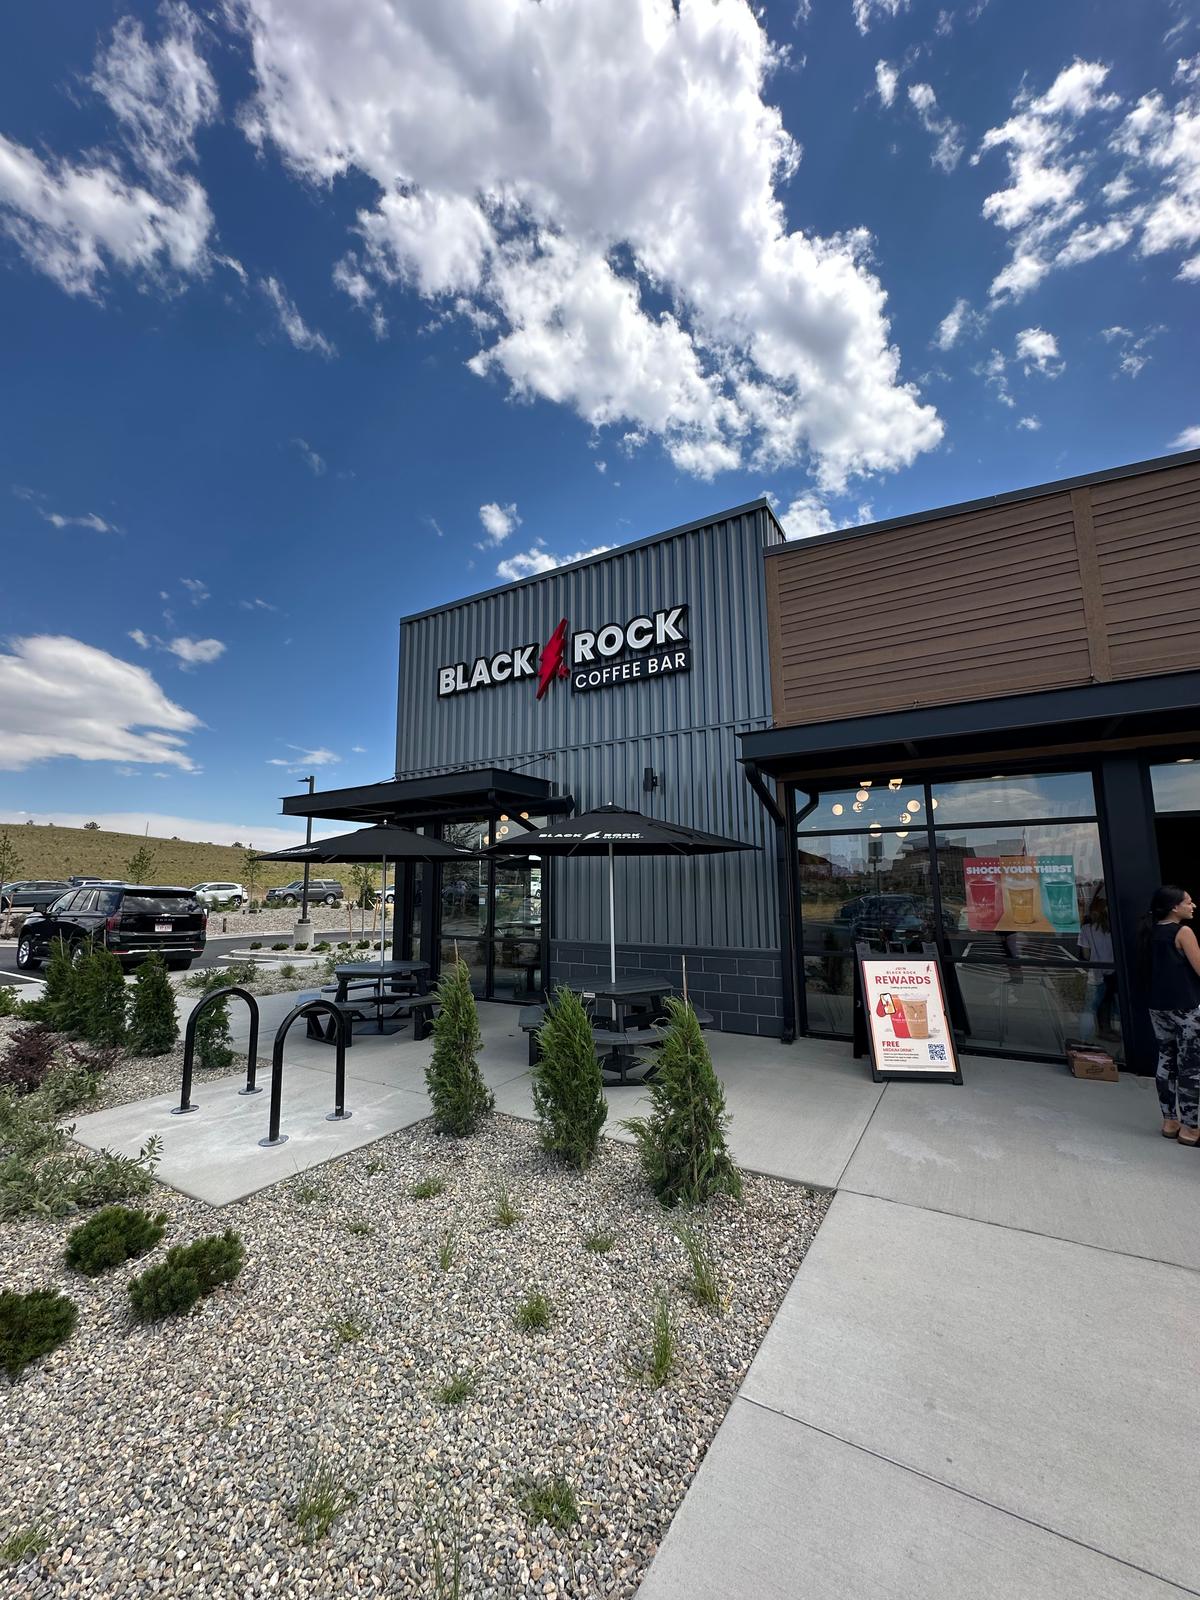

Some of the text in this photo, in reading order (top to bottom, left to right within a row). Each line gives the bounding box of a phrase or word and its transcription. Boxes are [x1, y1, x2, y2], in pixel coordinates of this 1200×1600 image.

[439, 607, 685, 695] BLACK ROCK
[574, 652, 687, 689] COFFEE BAR
[966, 864, 1073, 875] SHOCK YOUR THIRST
[874, 975, 931, 985] REWARDS
[881, 1040, 900, 1048] FREE
